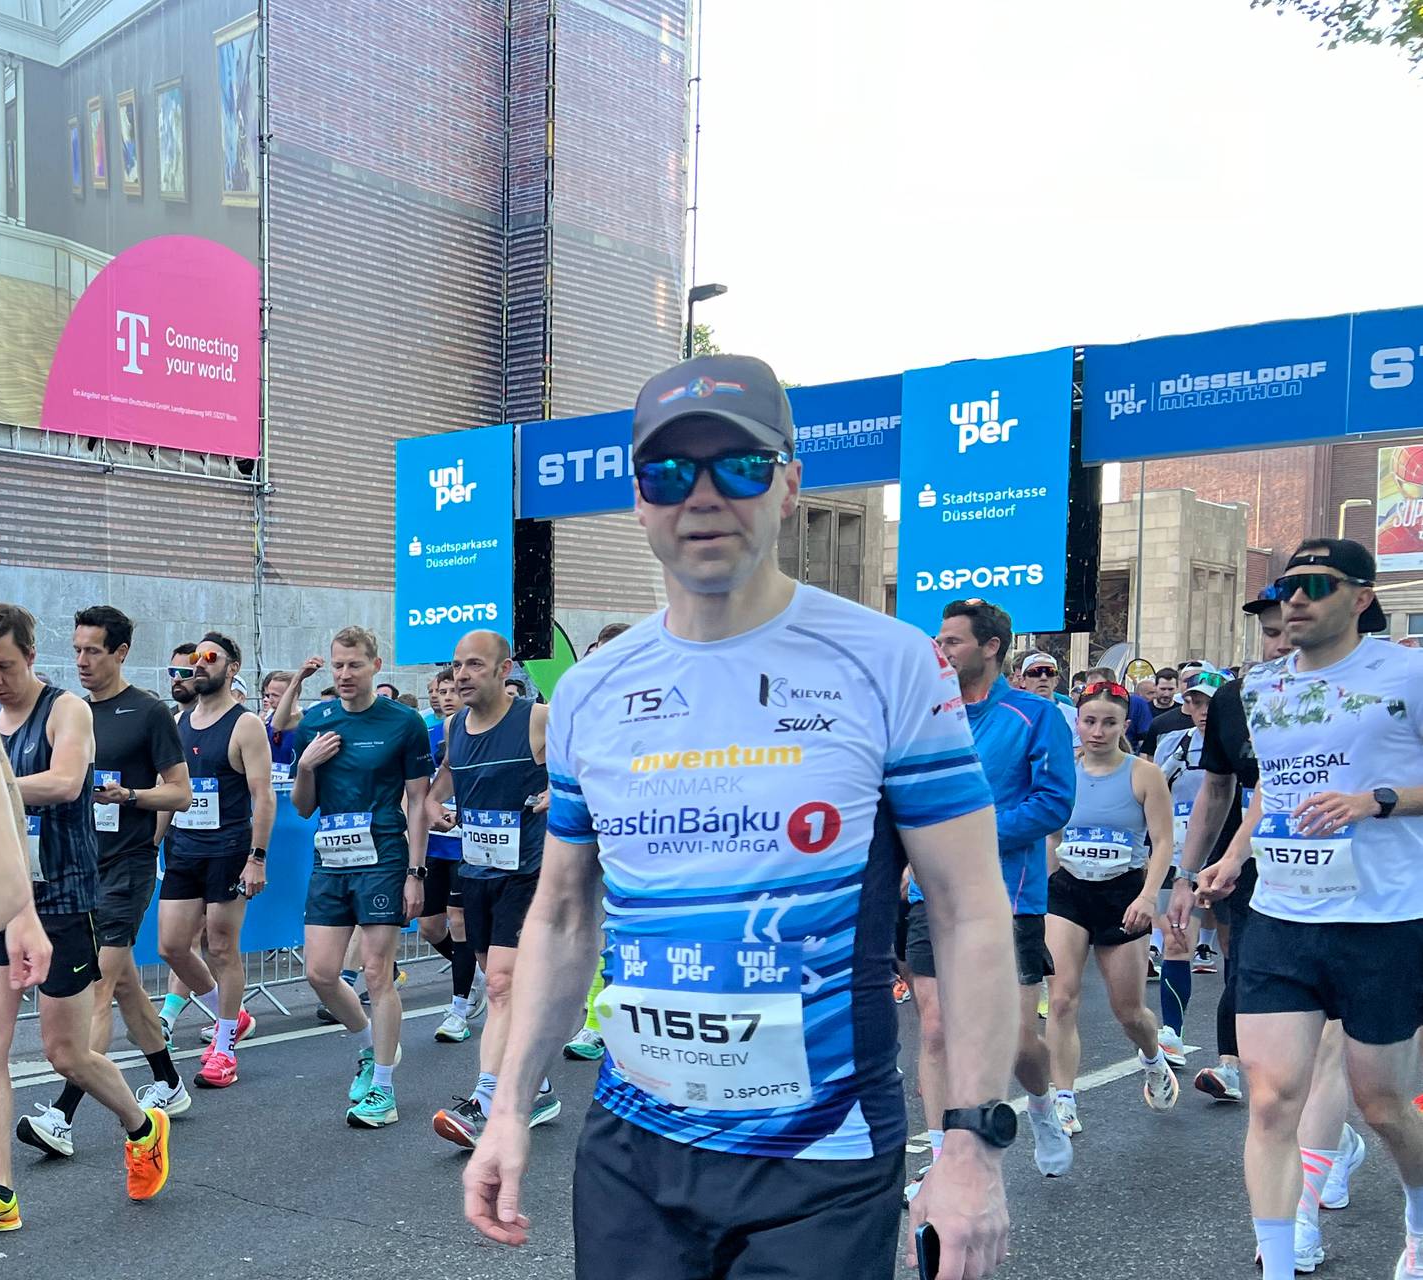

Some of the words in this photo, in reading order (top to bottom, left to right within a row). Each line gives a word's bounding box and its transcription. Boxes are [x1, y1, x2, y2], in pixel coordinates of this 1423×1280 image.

[165, 327, 239, 362] Connecting
[166, 357, 196, 375] your
[198, 361, 237, 383] world.
[1160, 361, 1326, 395] DÜSSELDORF
[1370, 345, 1423, 390] S
[1105, 383, 1135, 404] uni
[1158, 380, 1303, 411] MARATHON
[949, 390, 1000, 425] uni
[1110, 398, 1146, 420] per
[958, 418, 1018, 454] per
[429, 459, 464, 488] uni
[538, 445, 634, 486] STA
[435, 482, 477, 511] per
[942, 486, 1047, 507] Stadtsparkasse
[942, 504, 1017, 523] Düsseldorf
[425, 538, 498, 555] Stadtsparkasse
[425, 553, 477, 569] Düsseldorf
[916, 563, 1045, 592] D.SPORTS
[408, 602, 498, 627] D.SPORTS
[623, 685, 690, 716] TSA
[790, 688, 843, 701] KIEVRA
[630, 743, 802, 773] inventum
[1262, 752, 1350, 772] UNIVERSAL
[628, 776, 745, 798] FINNMARK
[1272, 770, 1329, 786] DECOR
[322, 833, 362, 847] 11750
[468, 831, 509, 845] 10989
[1067, 845, 1119, 859] 14991
[1265, 847, 1335, 866] 15787
[620, 940, 640, 960] uni
[666, 943, 702, 964] uni
[737, 945, 776, 967] uni
[623, 960, 648, 981] per
[672, 964, 715, 985] per
[743, 966, 791, 988] per
[620, 1003, 762, 1045] 11557
[640, 1043, 671, 1062] PER
[674, 1050, 749, 1067] TORLEIV
[724, 1081, 800, 1099] D.SPORTS
